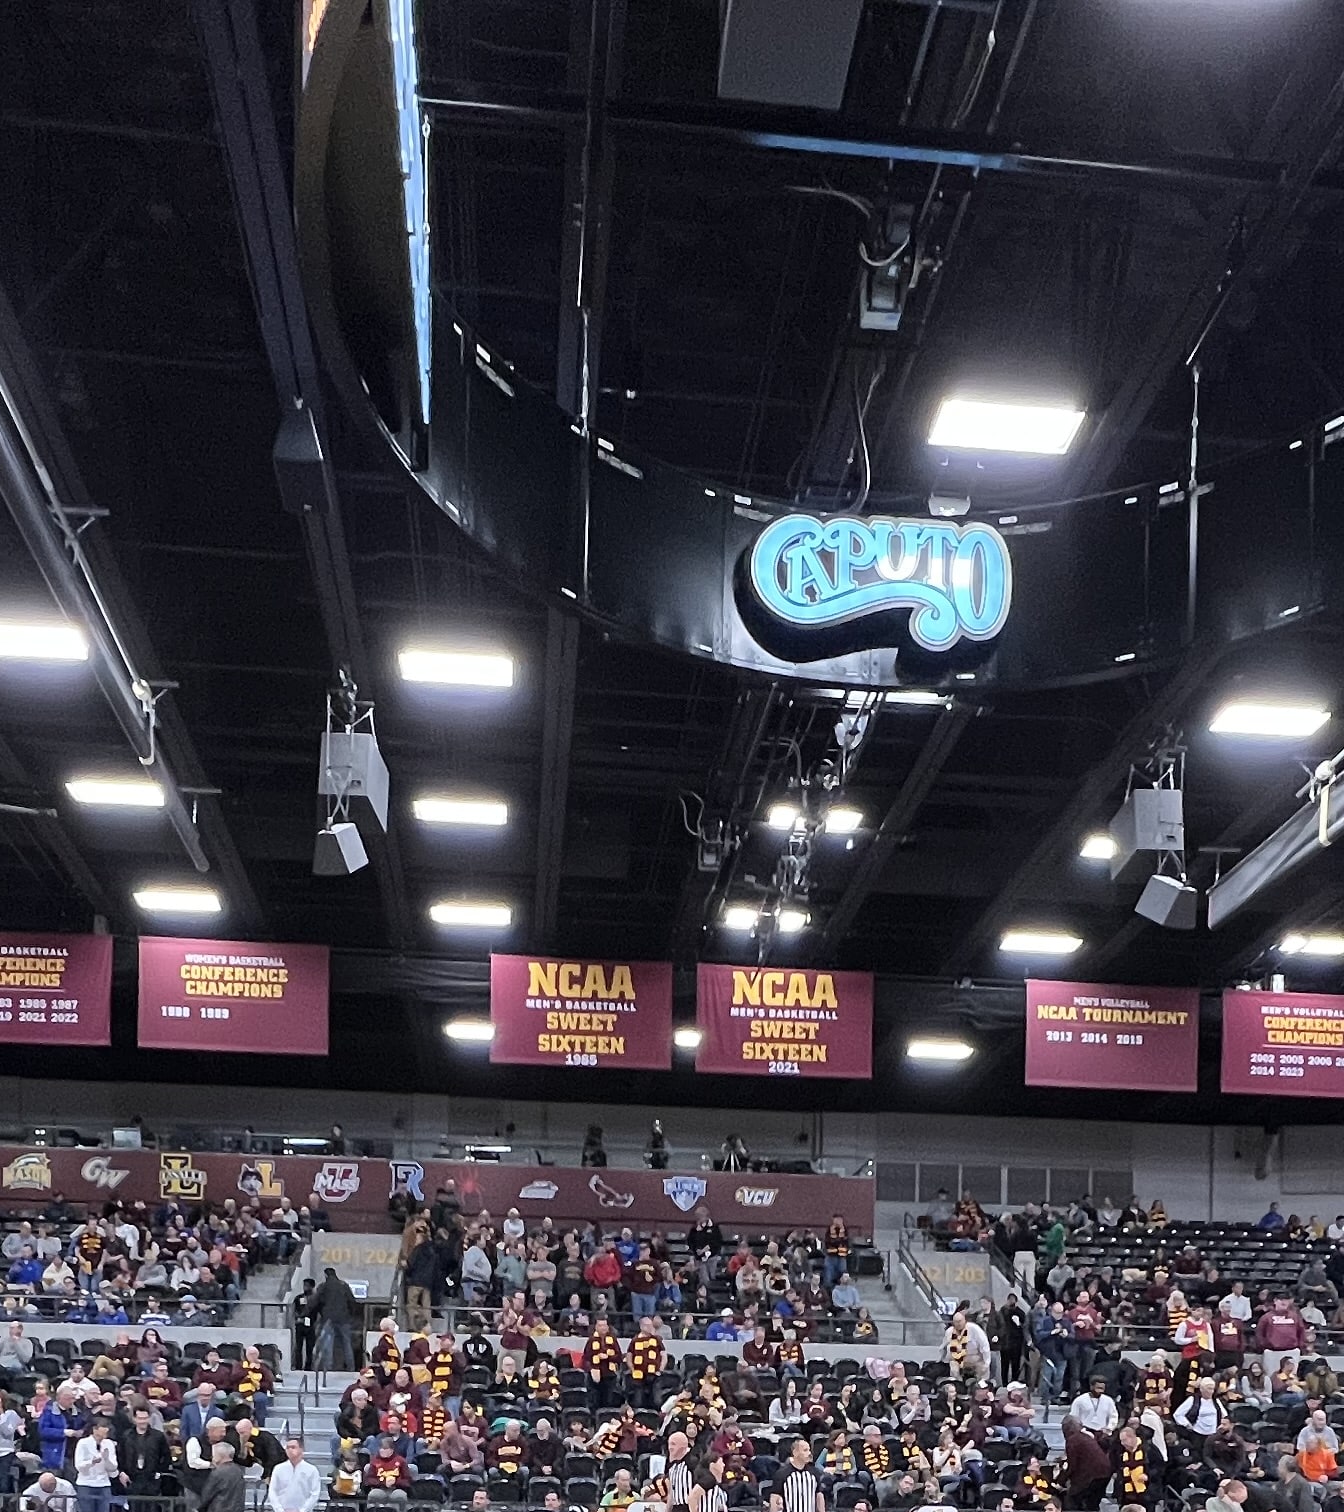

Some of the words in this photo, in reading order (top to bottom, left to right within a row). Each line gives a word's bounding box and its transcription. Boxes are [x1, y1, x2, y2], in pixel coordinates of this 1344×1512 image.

[752, 514, 1011, 651] CAPUTO
[180, 964, 288, 983] CONFERENCE
[528, 962, 636, 999] NCAA
[185, 981, 282, 997] CHAMPIONS
[732, 971, 838, 1008] NCAA
[526, 999, 561, 1009] MEN'S
[566, 1001, 636, 1011] BASKETBALL
[730, 1007, 765, 1017] MEN'S
[769, 1009, 838, 1020] BASKETBALL
[547, 1012, 617, 1031] SWEET
[1037, 1005, 1078, 1020] NCAA
[1083, 1008, 1188, 1025] TOURNAMENT
[751, 1021, 819, 1039] SWEET
[1081, 1032, 1107, 1043] 2014
[1268, 1031, 1344, 1045] CHAMPIONS
[538, 1035, 625, 1054] SIXTEEN
[742, 1042, 827, 1062] SIXTEEN
[768, 1062, 800, 1074] 2021
[81, 1156, 129, 1189] GW
[743, 1188, 775, 1206] VCU
